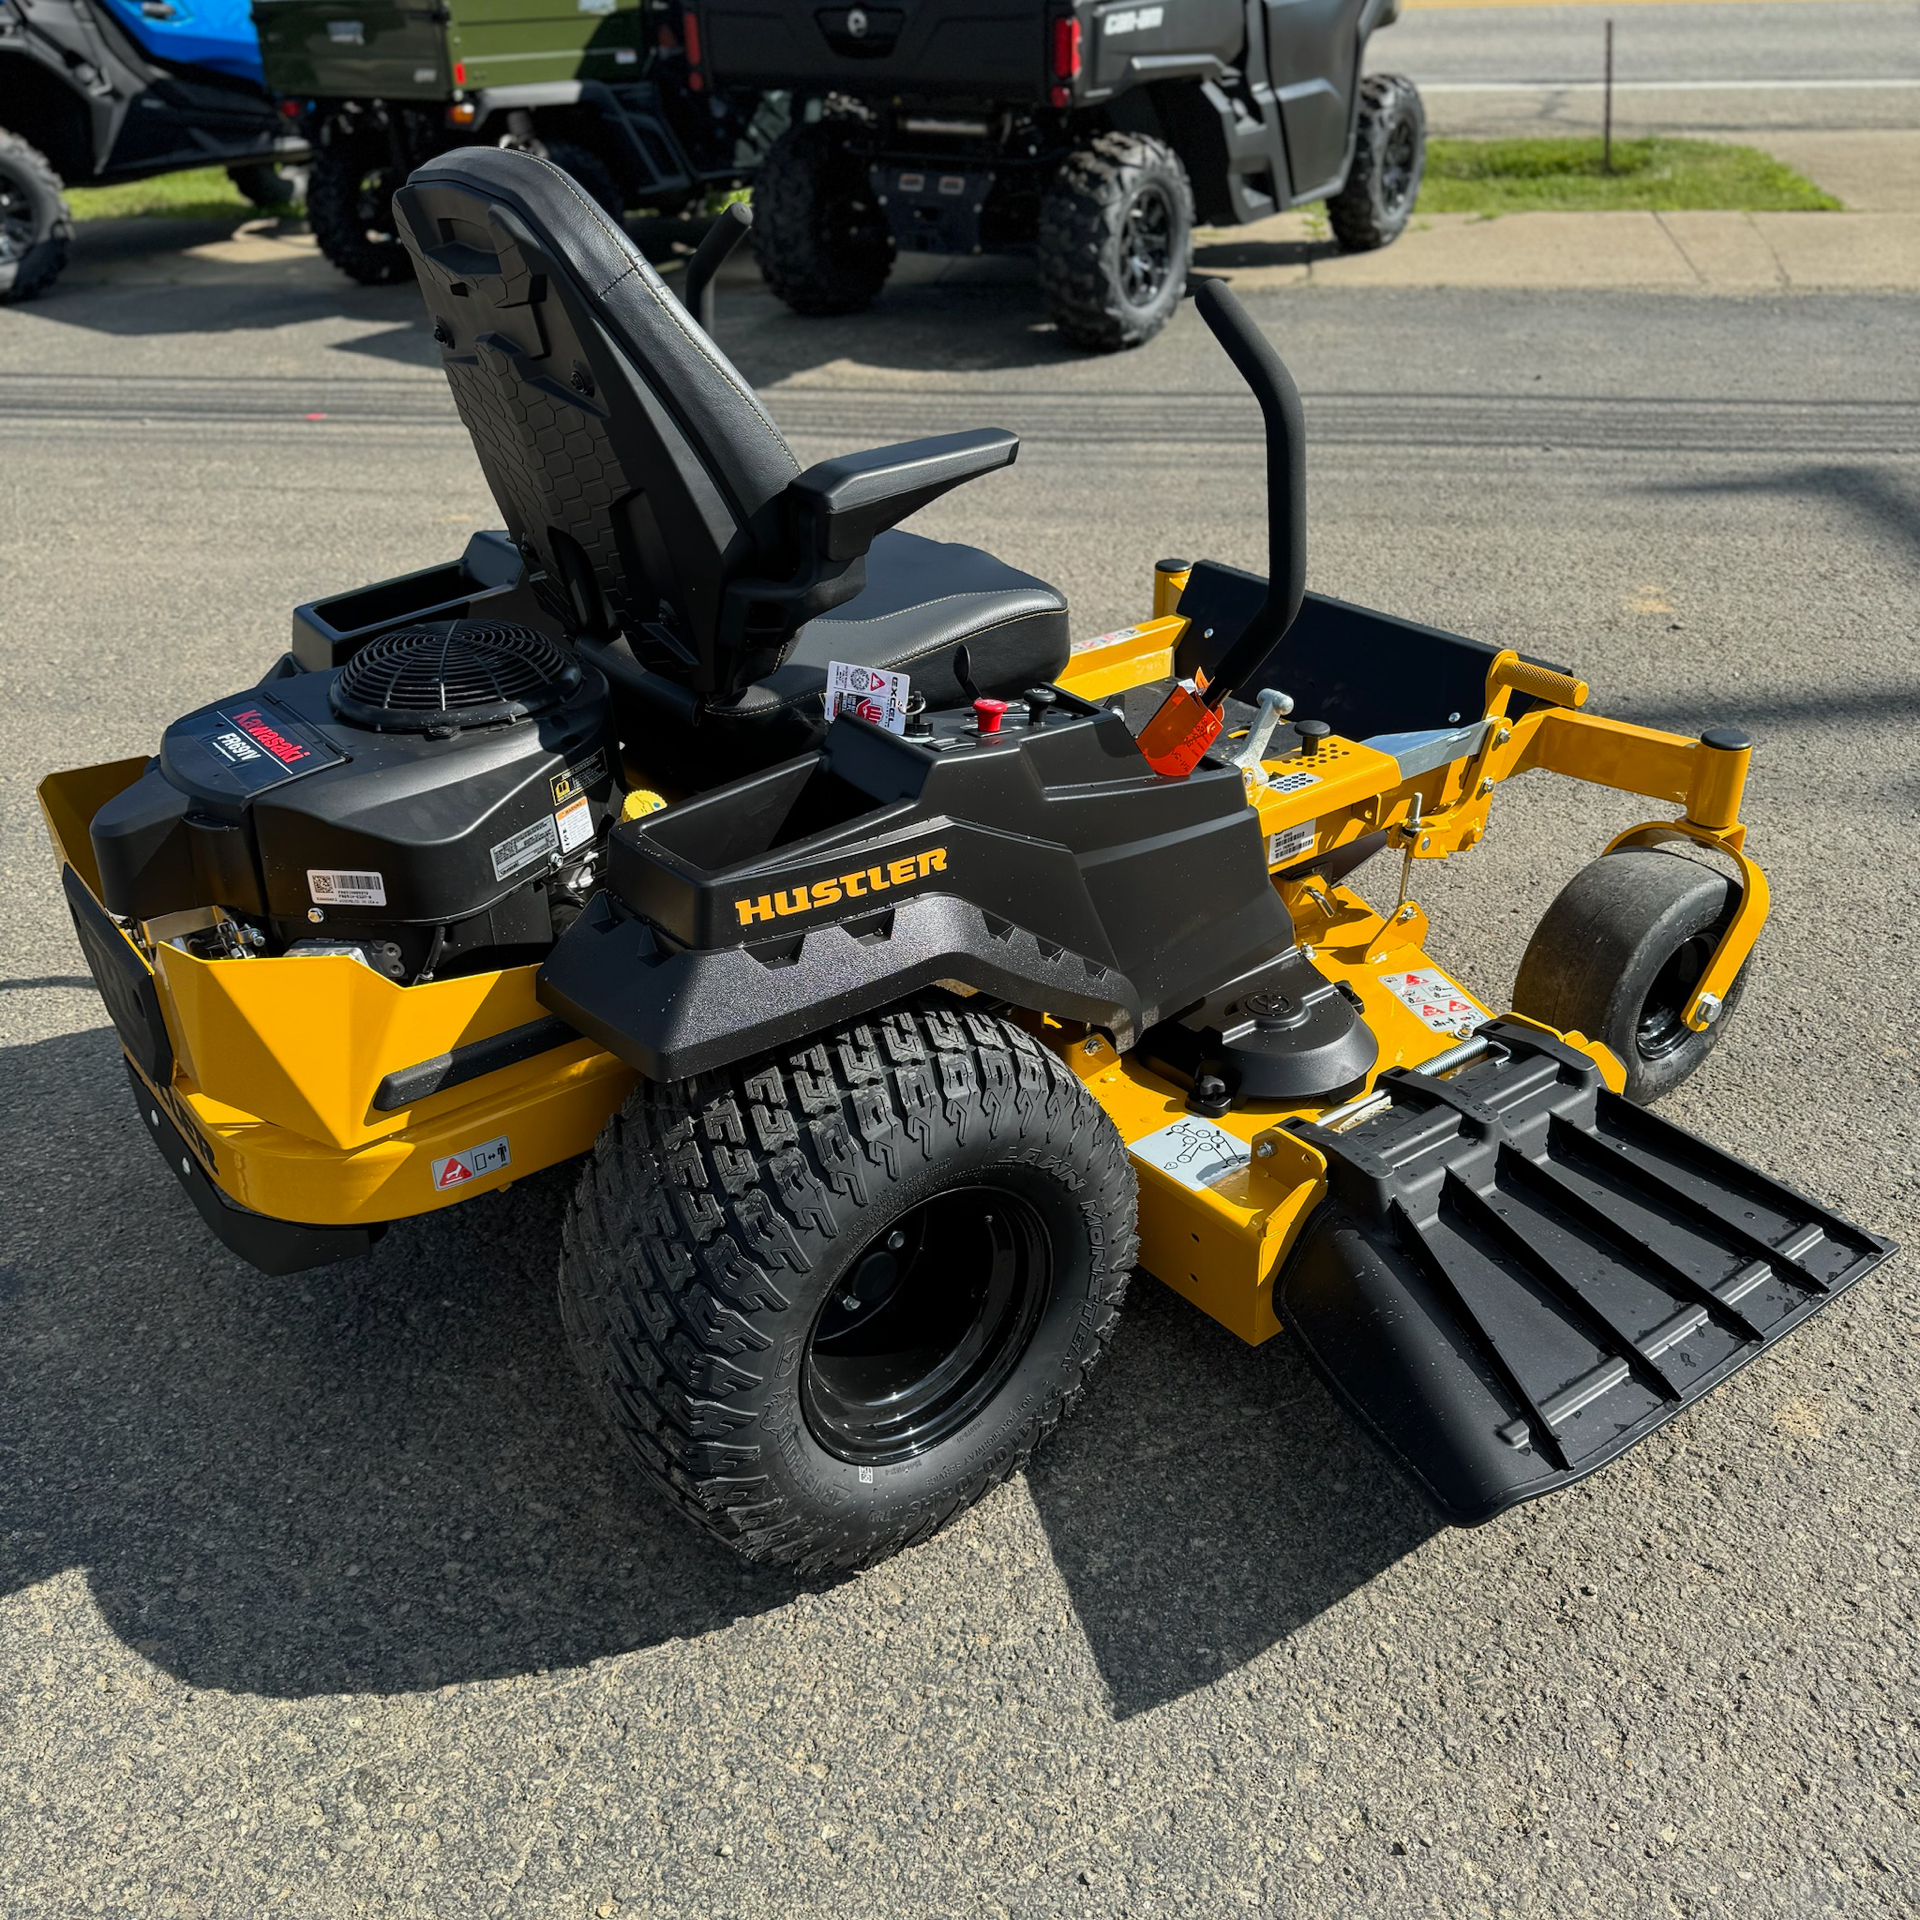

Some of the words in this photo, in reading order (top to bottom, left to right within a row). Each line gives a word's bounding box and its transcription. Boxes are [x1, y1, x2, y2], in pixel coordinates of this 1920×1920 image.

[887, 676, 898, 728] EXCEL
[217, 732, 262, 761] FR691V
[232, 709, 311, 763] Kawasaki
[735, 847, 948, 926] HUSTLER
[996, 1147, 1088, 1191] LAWN
[1061, 1199, 1106, 1373] MONSTER
[1017, 1393, 1035, 1414] NOT
[1002, 1411, 1019, 1433] FOR
[963, 1431, 1002, 1467] HIGHWAY
[925, 1461, 962, 1487] SERVICE
